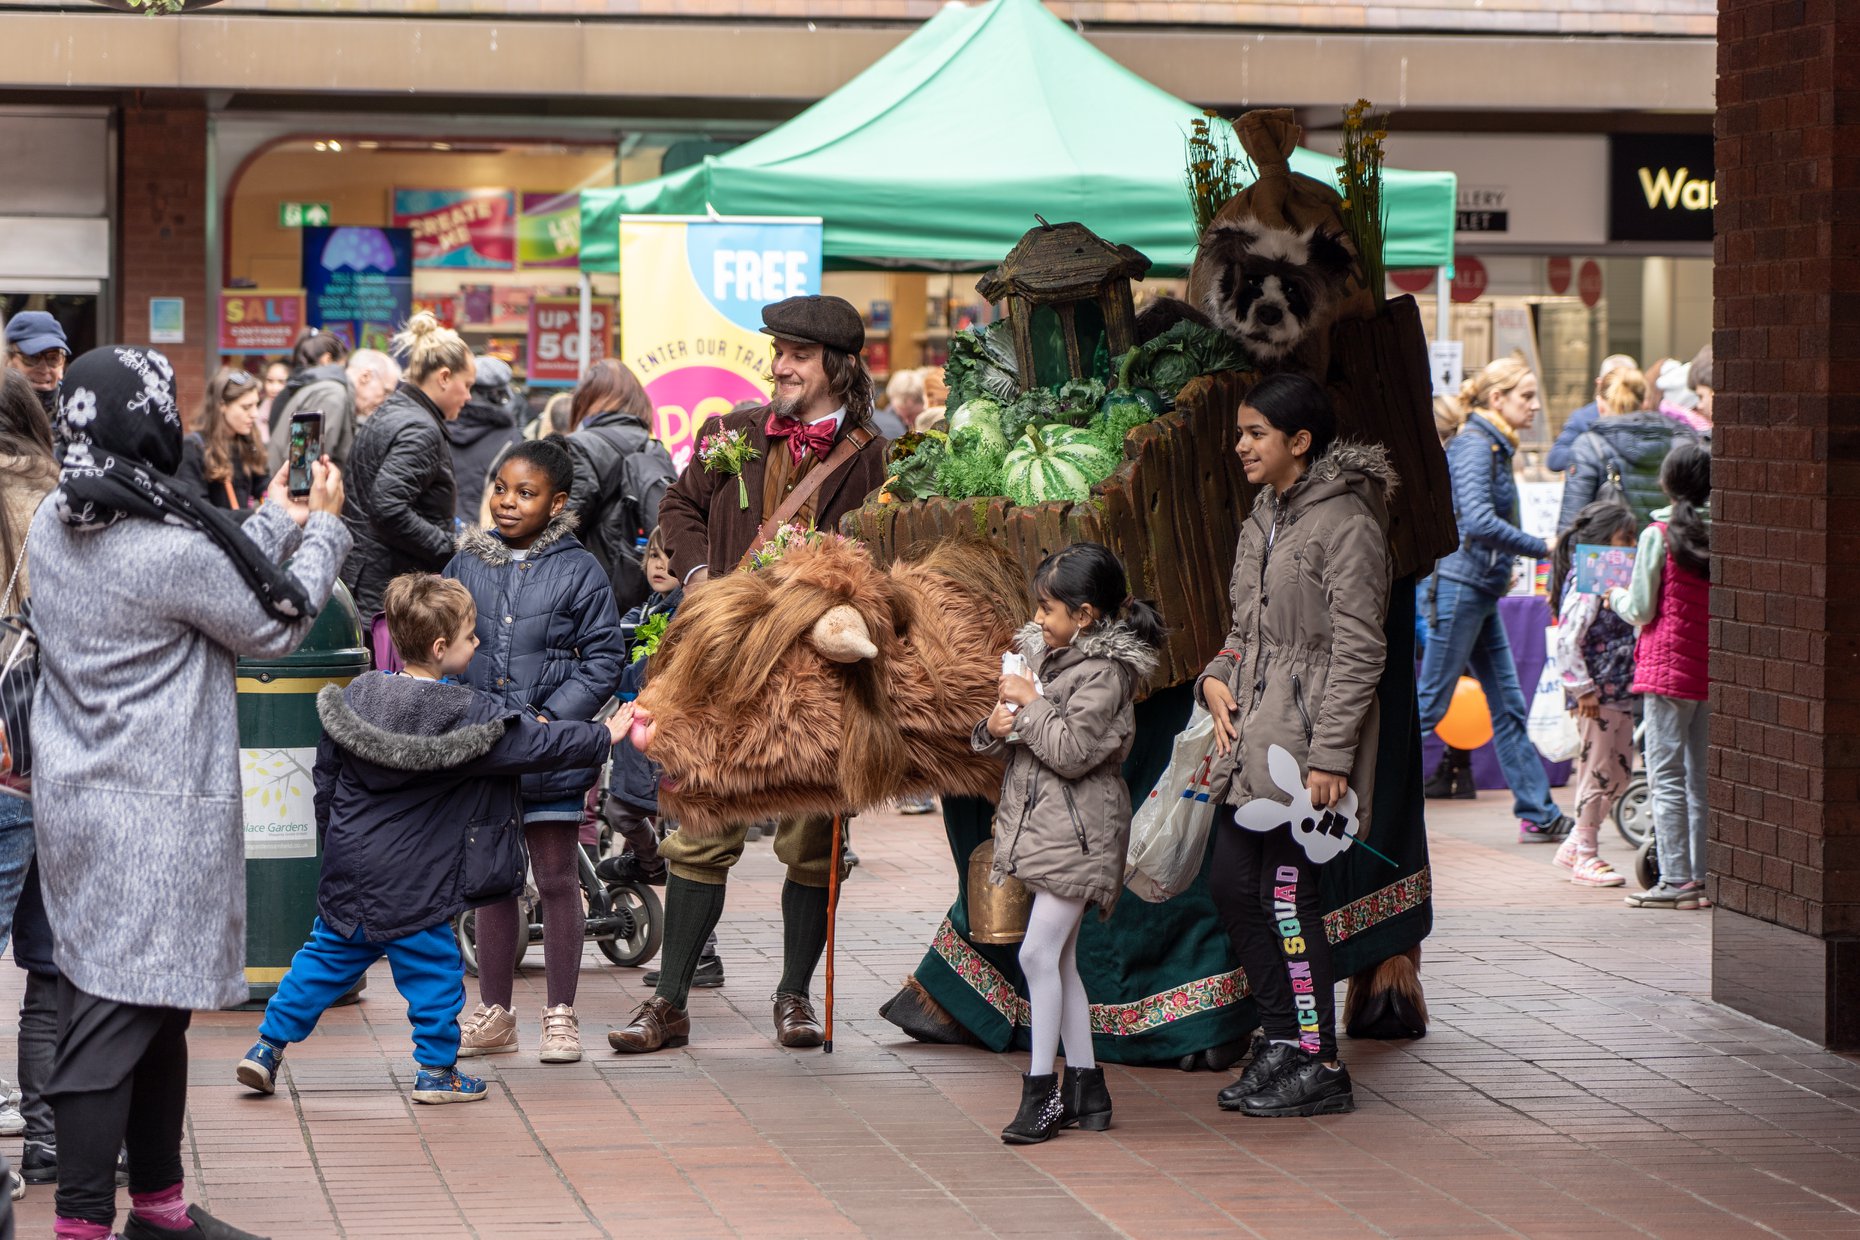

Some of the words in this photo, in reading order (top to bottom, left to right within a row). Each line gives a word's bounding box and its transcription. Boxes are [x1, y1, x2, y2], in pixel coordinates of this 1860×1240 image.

[713, 249, 809, 302] FREE
[225, 298, 298, 324] SALE
[537, 310, 571, 330] UP
[637, 340, 689, 374] ENTER
[696, 338, 727, 357] OUR
[267, 822, 309, 833] Gardens
[1273, 864, 1307, 956] SQUAD
